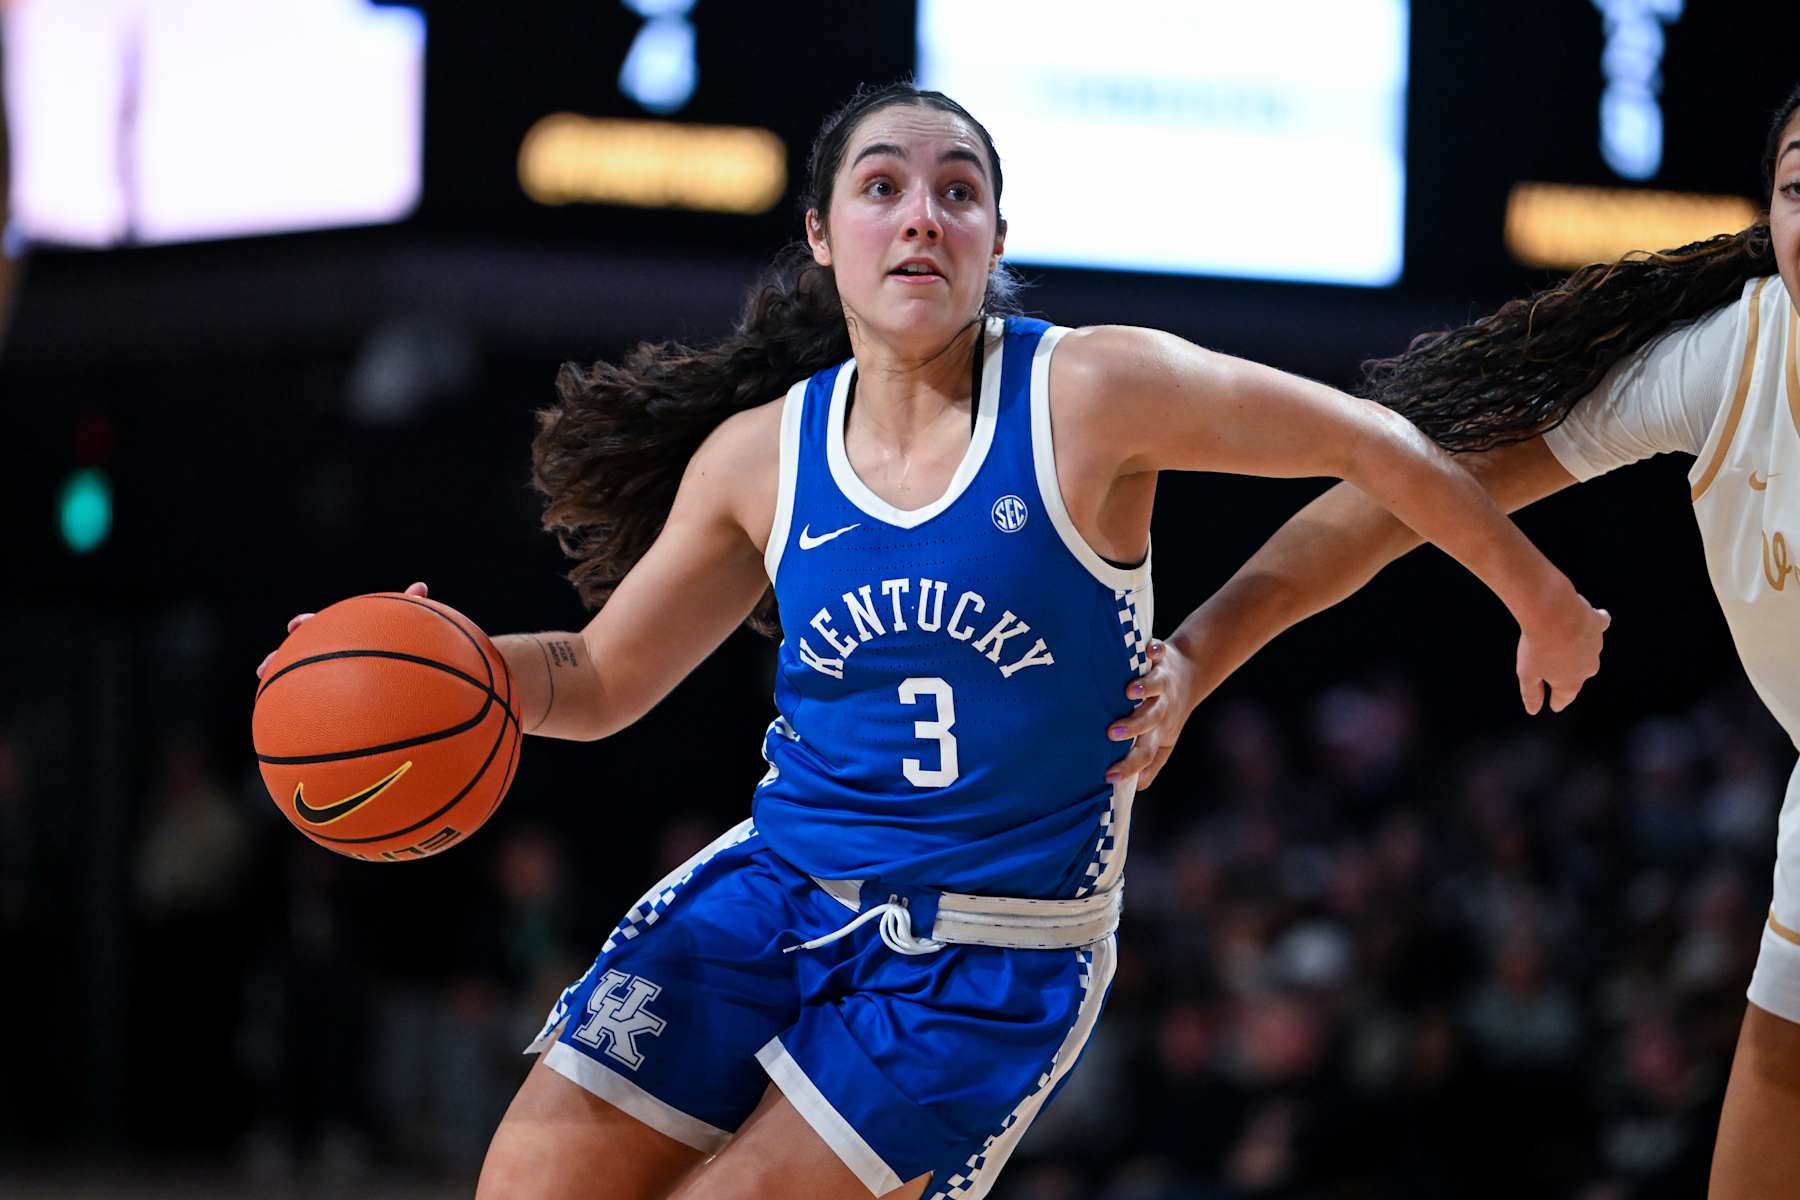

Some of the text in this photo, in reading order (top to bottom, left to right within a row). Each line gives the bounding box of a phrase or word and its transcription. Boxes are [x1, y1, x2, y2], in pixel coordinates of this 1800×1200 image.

[994, 498, 1026, 531] SEC
[800, 578, 1055, 679] KENTUCKY
[898, 677, 959, 788] 3
[572, 968, 667, 1072] UK
